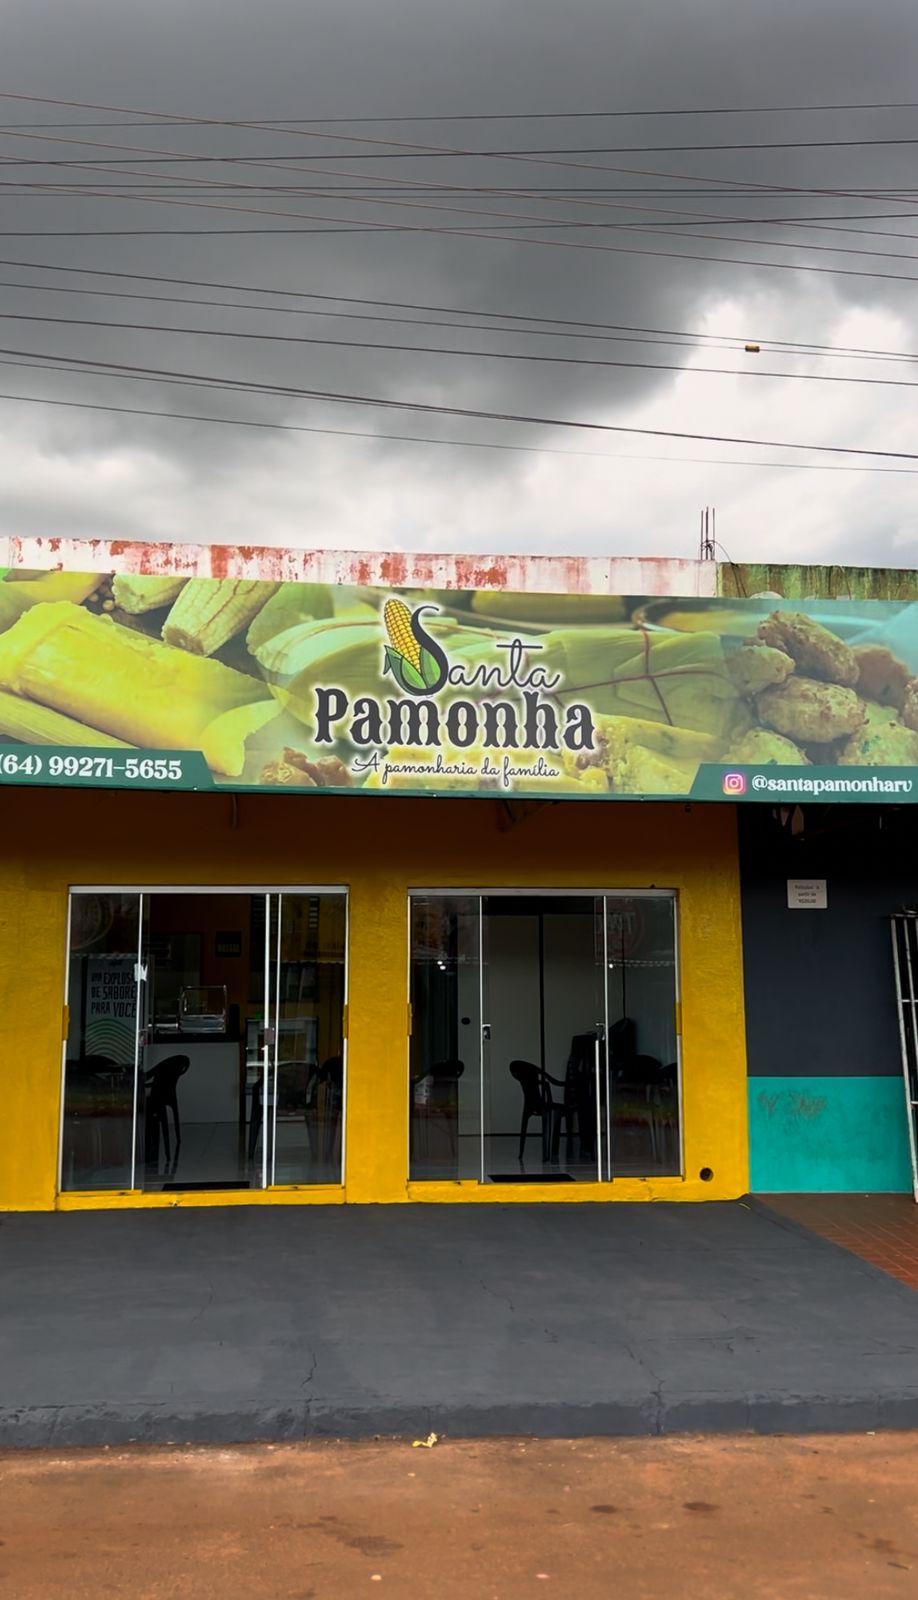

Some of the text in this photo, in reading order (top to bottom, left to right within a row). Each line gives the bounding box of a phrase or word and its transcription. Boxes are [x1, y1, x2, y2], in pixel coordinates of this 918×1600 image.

[398, 605, 561, 696] Santa
[314, 687, 596, 751] Pamonha
[49, 755, 183, 780] 99271-5655
[351, 752, 560, 788] A pamonharia da família
[751, 774, 913, 796] @santapamonharv
